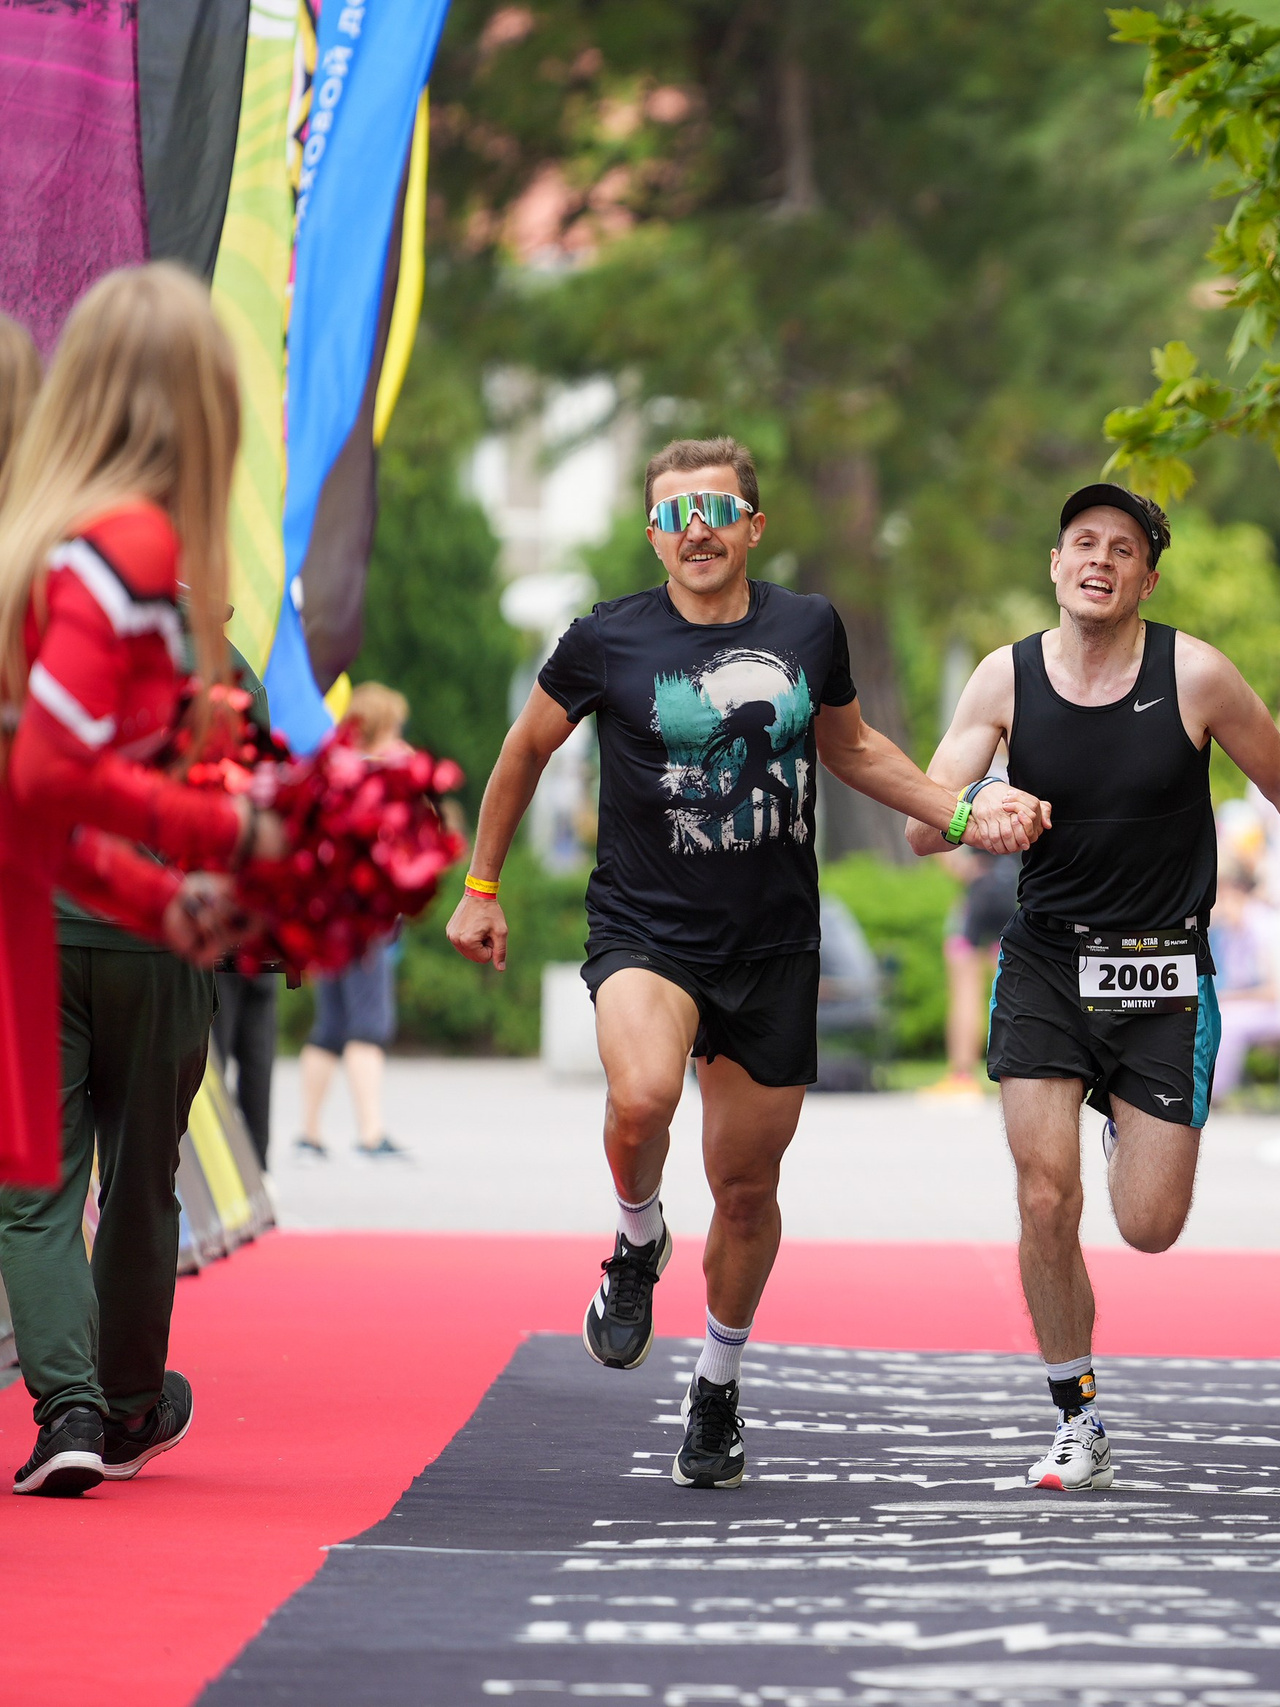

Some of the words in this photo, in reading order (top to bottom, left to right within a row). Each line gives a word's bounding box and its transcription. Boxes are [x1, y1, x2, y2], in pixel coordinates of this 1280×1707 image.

[1121, 938, 1137, 946] IRON
[1143, 937, 1158, 946] STAR
[1098, 963, 1179, 991] 2006
[1121, 1000, 1156, 1008] DMITRIY
[630, 1467, 926, 1483] ION
